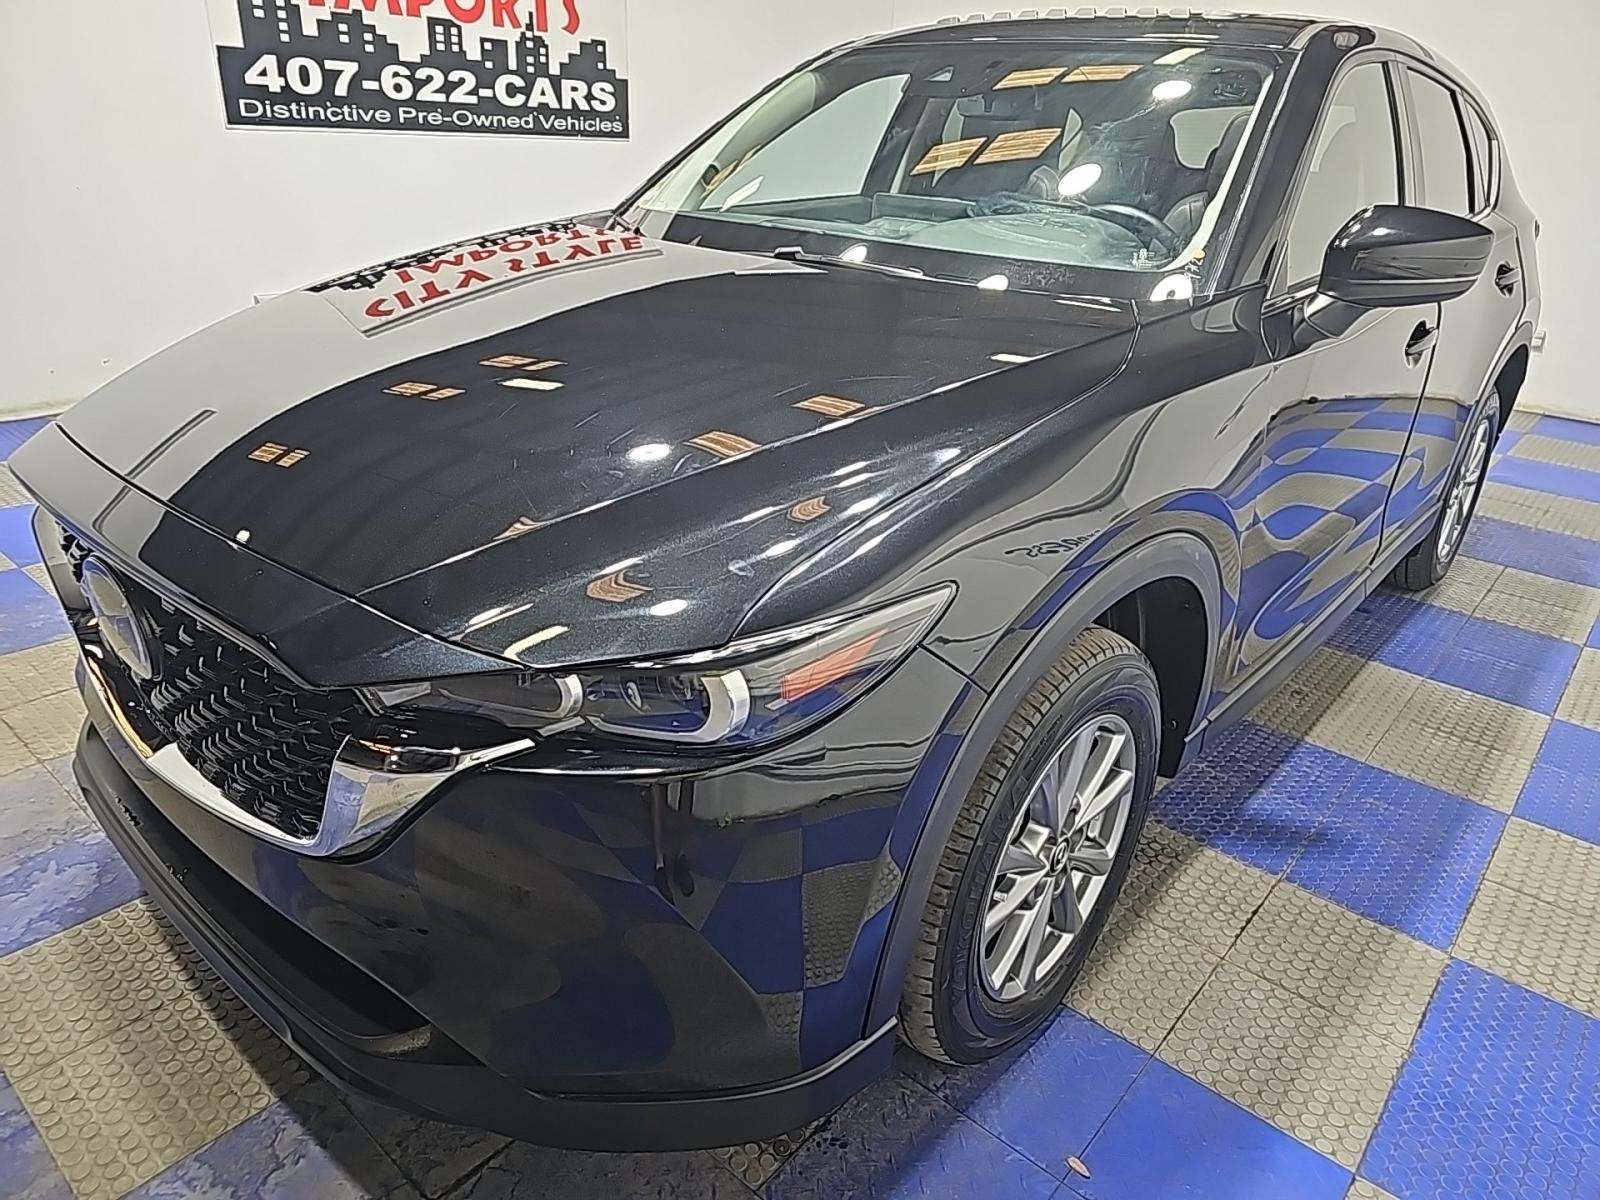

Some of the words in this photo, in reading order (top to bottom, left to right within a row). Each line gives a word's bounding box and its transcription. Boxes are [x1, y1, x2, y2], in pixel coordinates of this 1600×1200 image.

[305, 0, 581, 34] PORTS
[244, 54, 617, 112] 407-622-CARS
[238, 98, 392, 124] Distinctive
[398, 106, 534, 130] Pre-Owned
[540, 115, 623, 134] Vehicles
